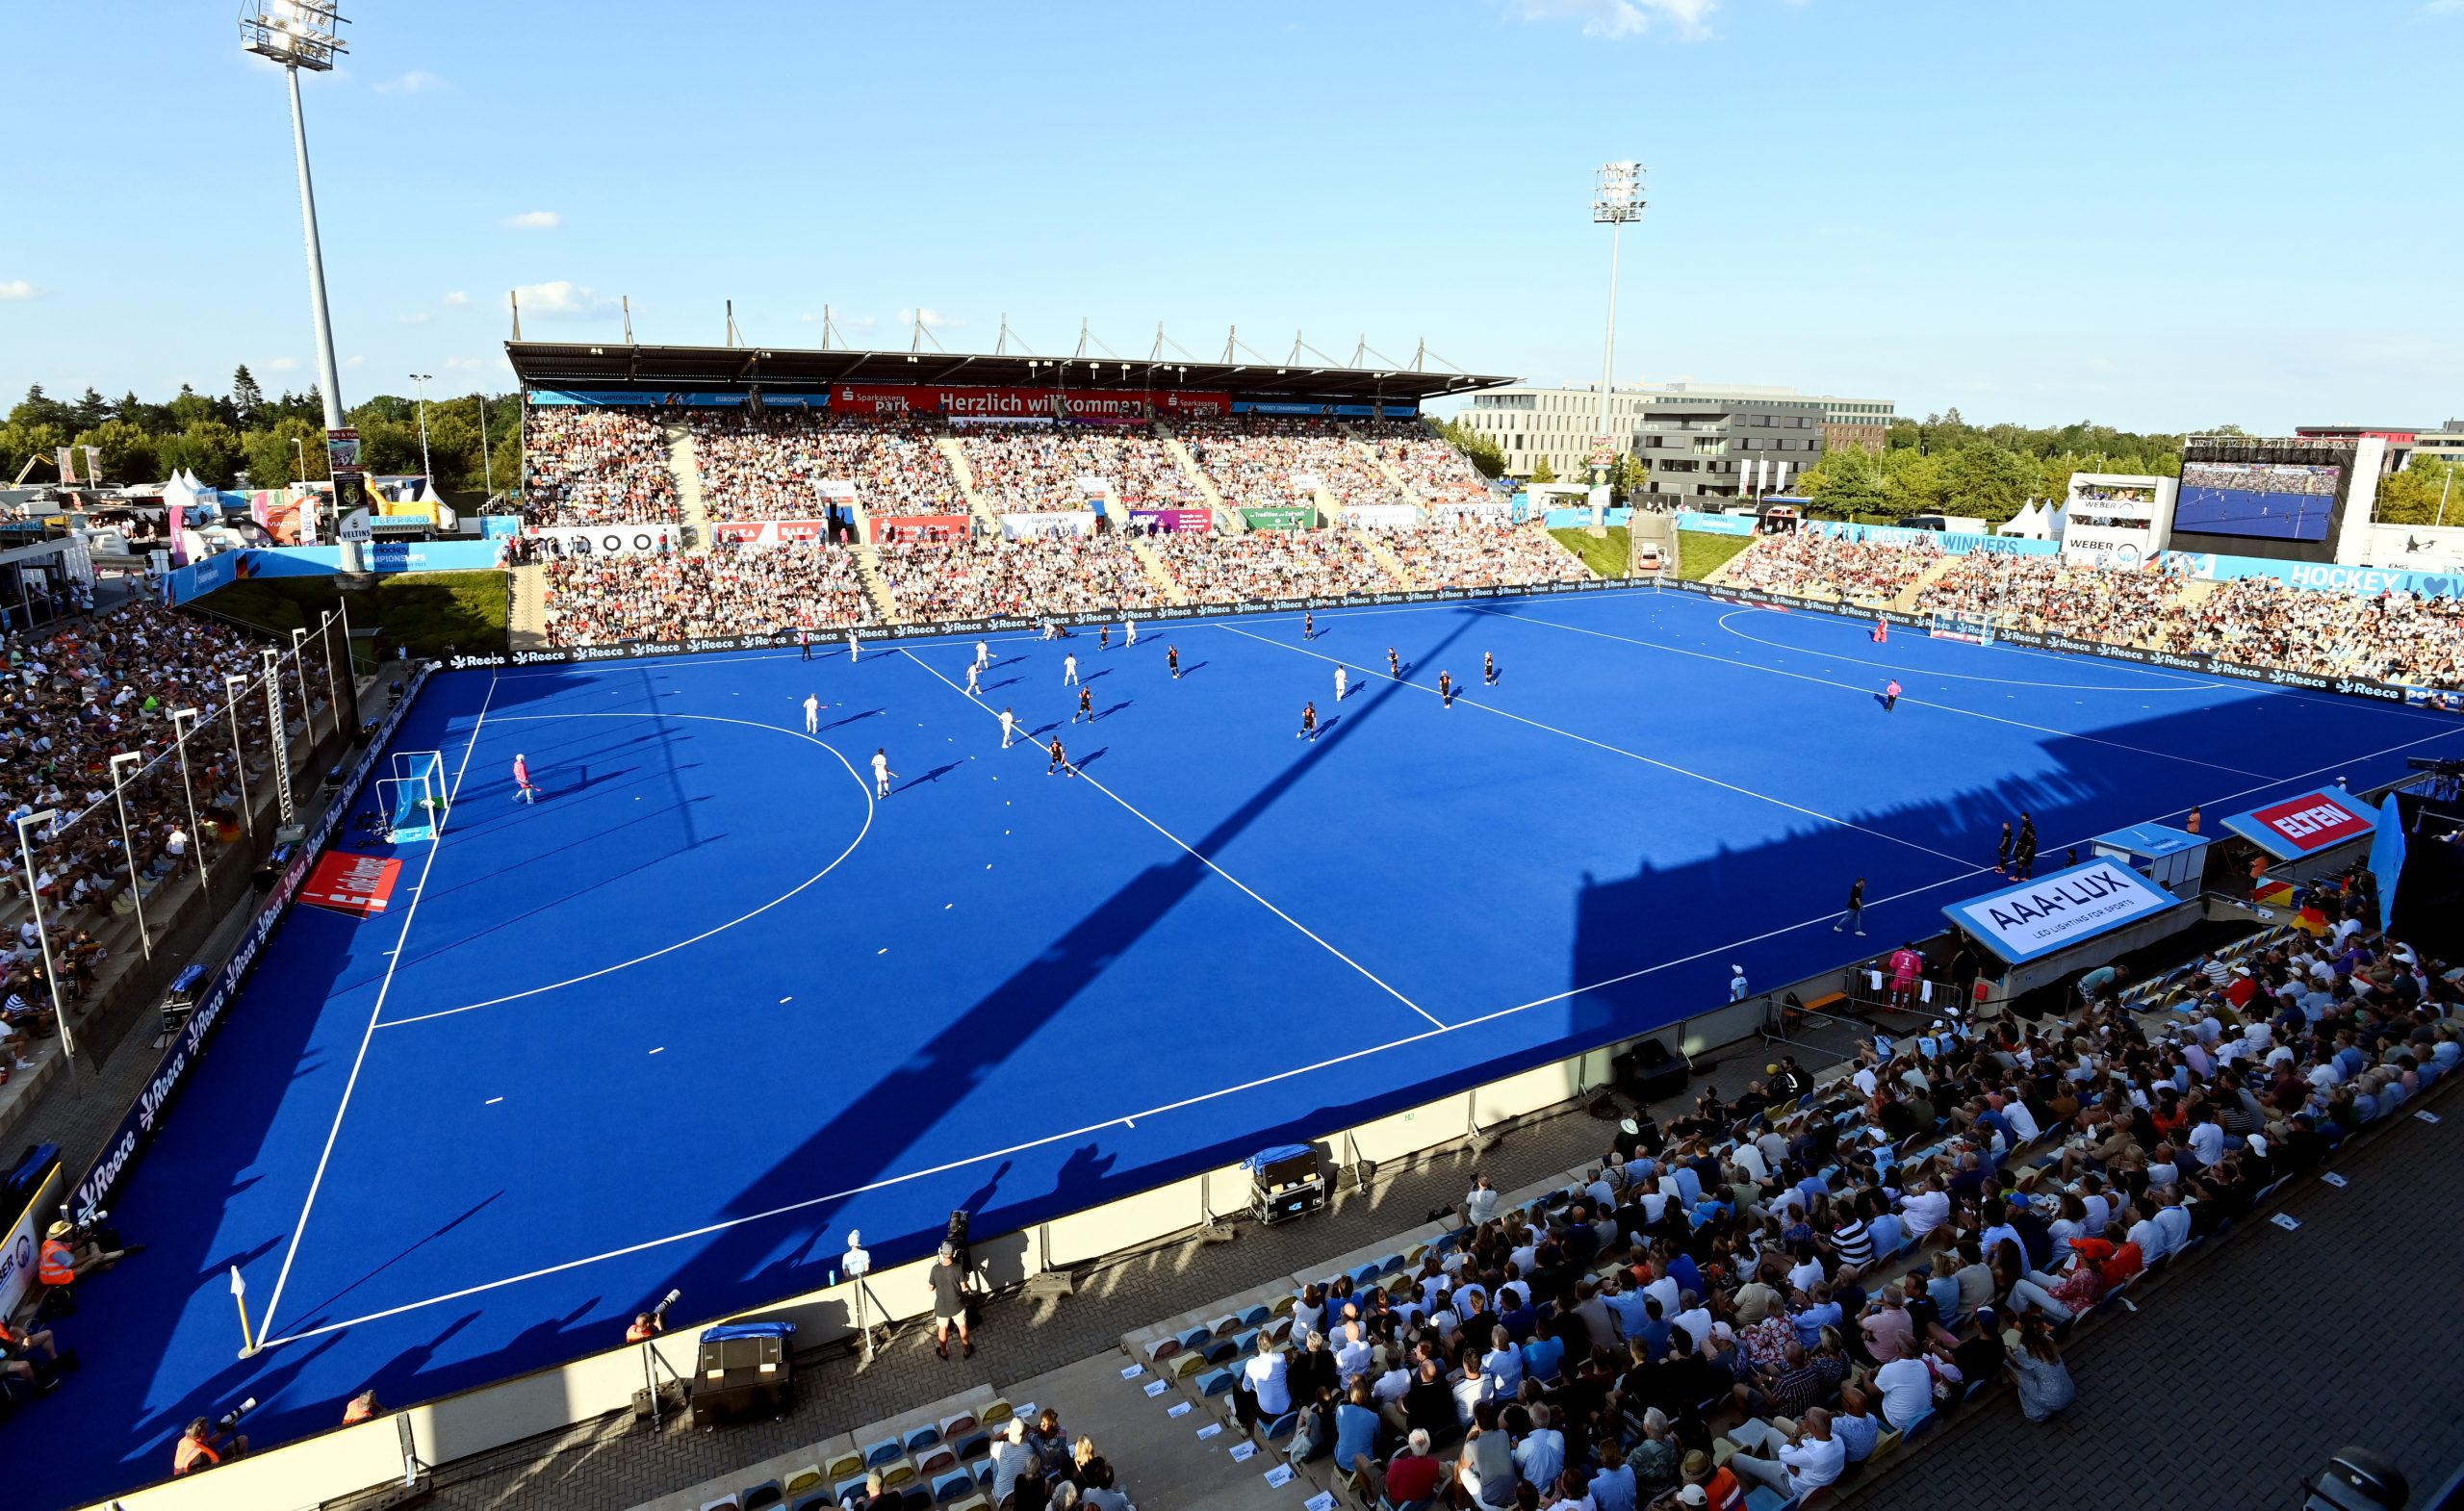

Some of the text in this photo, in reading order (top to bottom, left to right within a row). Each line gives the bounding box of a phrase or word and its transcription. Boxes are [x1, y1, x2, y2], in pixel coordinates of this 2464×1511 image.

[857, 393, 901, 402] Sparkassen
[939, 393, 1022, 411] Herzlich
[342, 529, 370, 539] VELTINS
[1943, 535, 2017, 554] WINNERS
[2070, 539, 2114, 551] WEBER
[363, 546, 409, 555] uroHockey
[2292, 564, 2400, 592] HOCKEY
[529, 651, 565, 662] Reece
[589, 647, 624, 657] Reece
[645, 643, 680, 653] Reece
[701, 639, 734, 649] Reece
[756, 635, 787, 645] Rece
[807, 632, 837, 641] Reece
[858, 629, 888, 638] Reece
[907, 625, 935, 635] Reece
[954, 622, 981, 631] Reece
[1000, 619, 1026, 627] Reece
[1087, 613, 1111, 621] Reece
[1128, 611, 1152, 619] Reece
[1168, 608, 1191, 616] Reece
[1208, 606, 1230, 614] Reece
[1245, 603, 1267, 611] Reece
[1281, 601, 1302, 609] Reece
[1660, 577, 1678, 586] Reece
[1689, 582, 1706, 591] Reece
[1718, 587, 1735, 596] Reece
[1748, 592, 1767, 601] Reece
[1780, 597, 1800, 606] Reece
[1813, 602, 1834, 611] Reece
[1849, 607, 1870, 617] Reece
[1886, 613, 1909, 623] Reece
[1925, 619, 1950, 629] Rece
[2013, 632, 2041, 643] Reece
[2060, 639, 2090, 651] Reece
[2111, 647, 2143, 659] Reece
[2164, 655, 2199, 668] Reece
[2223, 664, 2260, 677] Reece
[2286, 674, 2326, 687] Reece
[2354, 684, 2398, 698] Reece
[332, 802, 342, 822] Reece
[2272, 803, 2352, 839] ELTEN
[312, 832, 325, 857] Reece
[291, 860, 305, 889] Reece
[266, 897, 283, 929] Reece
[2033, 899, 2135, 939] LED LIGHTING FOR SPORTS
[236, 940, 256, 975] Reece
[1903, 957, 1910, 967] 1
[198, 990, 224, 1038] Reece
[154, 1052, 184, 1102] Reece
[94, 1130, 135, 1200] Reece
